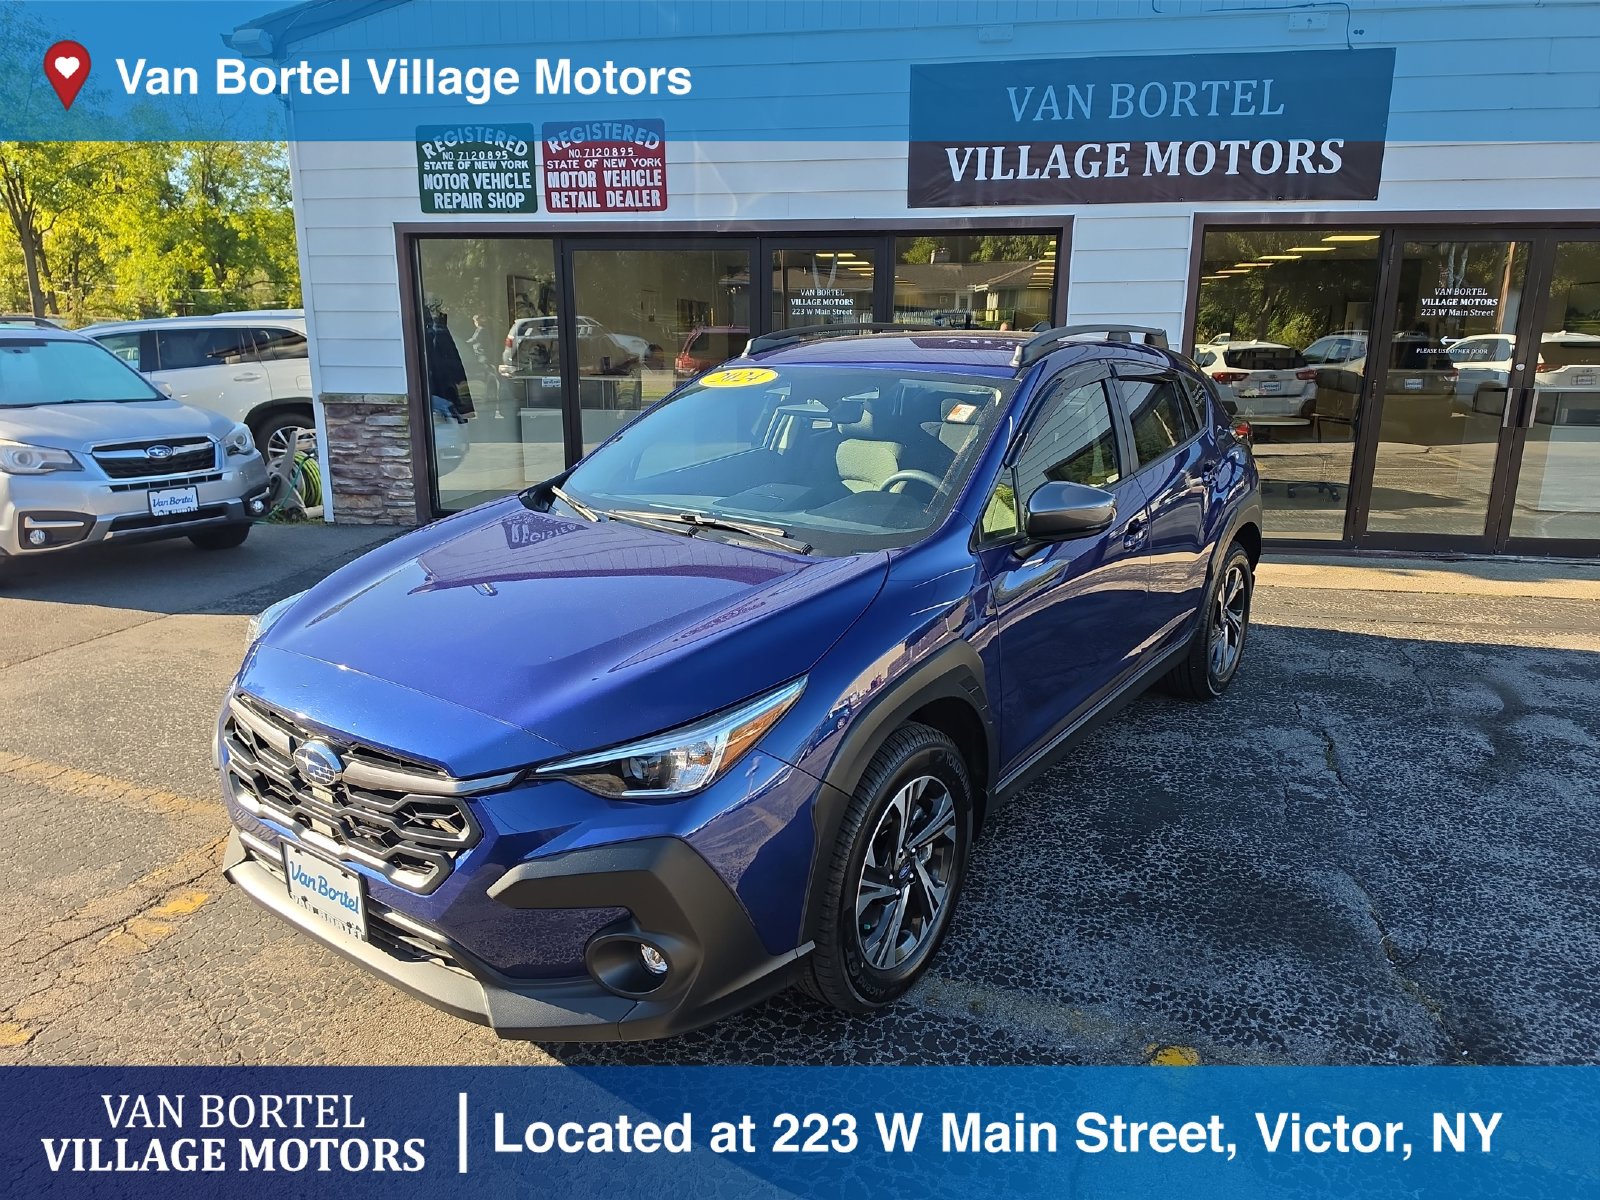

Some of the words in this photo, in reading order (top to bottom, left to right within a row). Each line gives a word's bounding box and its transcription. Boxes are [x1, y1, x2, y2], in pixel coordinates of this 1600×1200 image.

[1006, 83, 1095, 122] VAN
[1109, 79, 1285, 119] BORTEL
[422, 126, 528, 160] REGISTERED
[546, 122, 660, 154] REGISTERED
[457, 150, 509, 160] 7120895
[583, 147, 635, 157] 7120895
[423, 161, 454, 170] STATE
[457, 161, 472, 170] OF
[474, 160, 498, 169] NEW
[500, 160, 530, 169] YORK
[547, 160, 580, 169] STATE
[584, 159, 599, 168] OF
[603, 158, 627, 168] NEW
[631, 158, 662, 167] YORK
[945, 142, 1131, 182] VILLAGE
[1142, 138, 1344, 177] MOTORS
[423, 173, 470, 190] MOTOR
[472, 172, 532, 189] VEHICLE
[547, 171, 597, 188] MOTOR
[602, 169, 662, 187] VEHICLE
[433, 192, 483, 209] REPAIR
[487, 191, 525, 209] SHOP
[550, 191, 601, 209] RETAIL
[605, 190, 661, 208] DEALER
[800, 288, 816, 296] VAN
[816, 288, 845, 296] BORTEL
[1434, 288, 1453, 296] VAN
[1453, 288, 1488, 296] BORTEL
[790, 298, 821, 306] VILLAGE
[822, 298, 854, 306] MOTORS
[1421, 298, 1459, 306] VILLAGE
[1459, 298, 1499, 306] MOTORS
[832, 308, 853, 316] Street
[1420, 308, 1437, 316] 223
[1438, 308, 1448, 316] W
[1448, 308, 1469, 317] Main
[1469, 308, 1495, 317] Street
[1415, 347, 1437, 355] PLEASE
[152, 498, 169, 507] Van
[169, 494, 194, 506] Bortel
[289, 860, 317, 892] Van
[317, 874, 359, 915] Bortel
